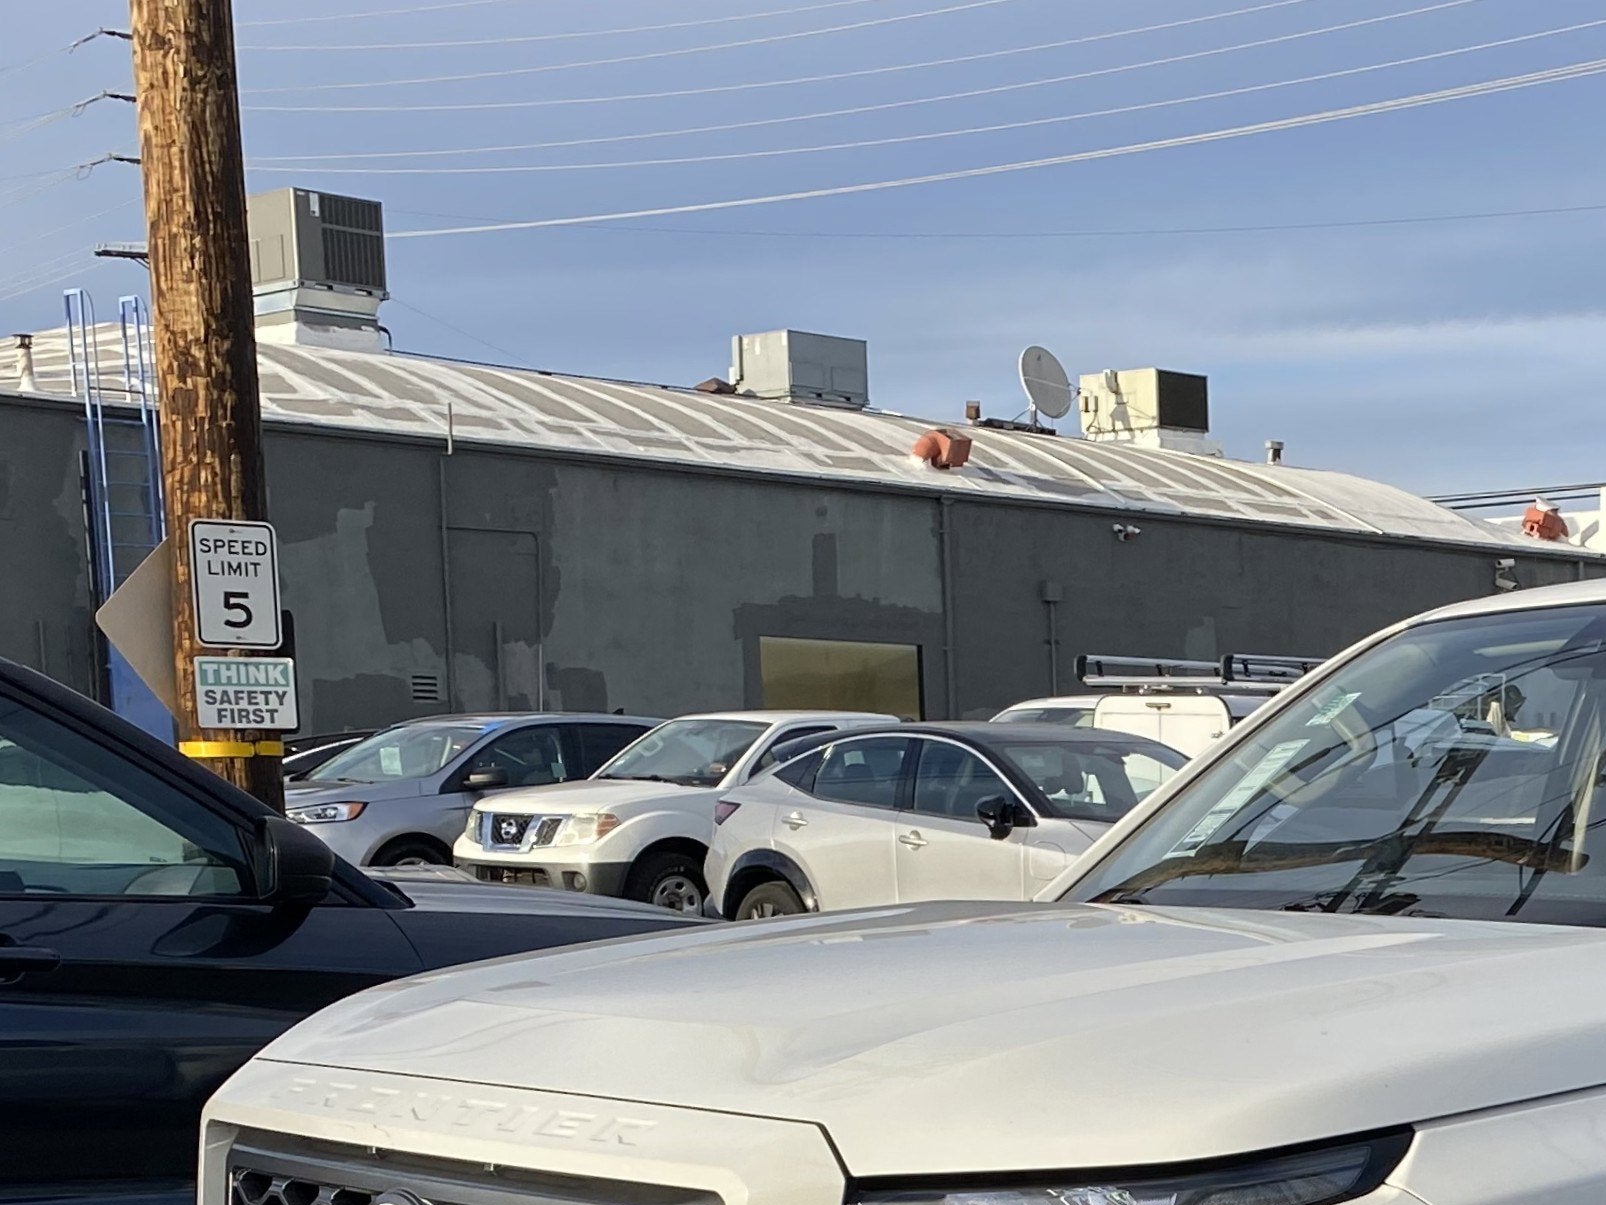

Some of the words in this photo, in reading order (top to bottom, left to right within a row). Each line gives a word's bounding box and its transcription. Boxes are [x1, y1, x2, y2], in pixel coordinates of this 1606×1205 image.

[199, 537, 267, 556] SPEED
[207, 559, 261, 577] LIMIT
[223, 590, 253, 629] 5
[201, 662, 289, 686] THINK
[204, 689, 288, 707] SAFETY
[216, 707, 279, 725] FIRST
